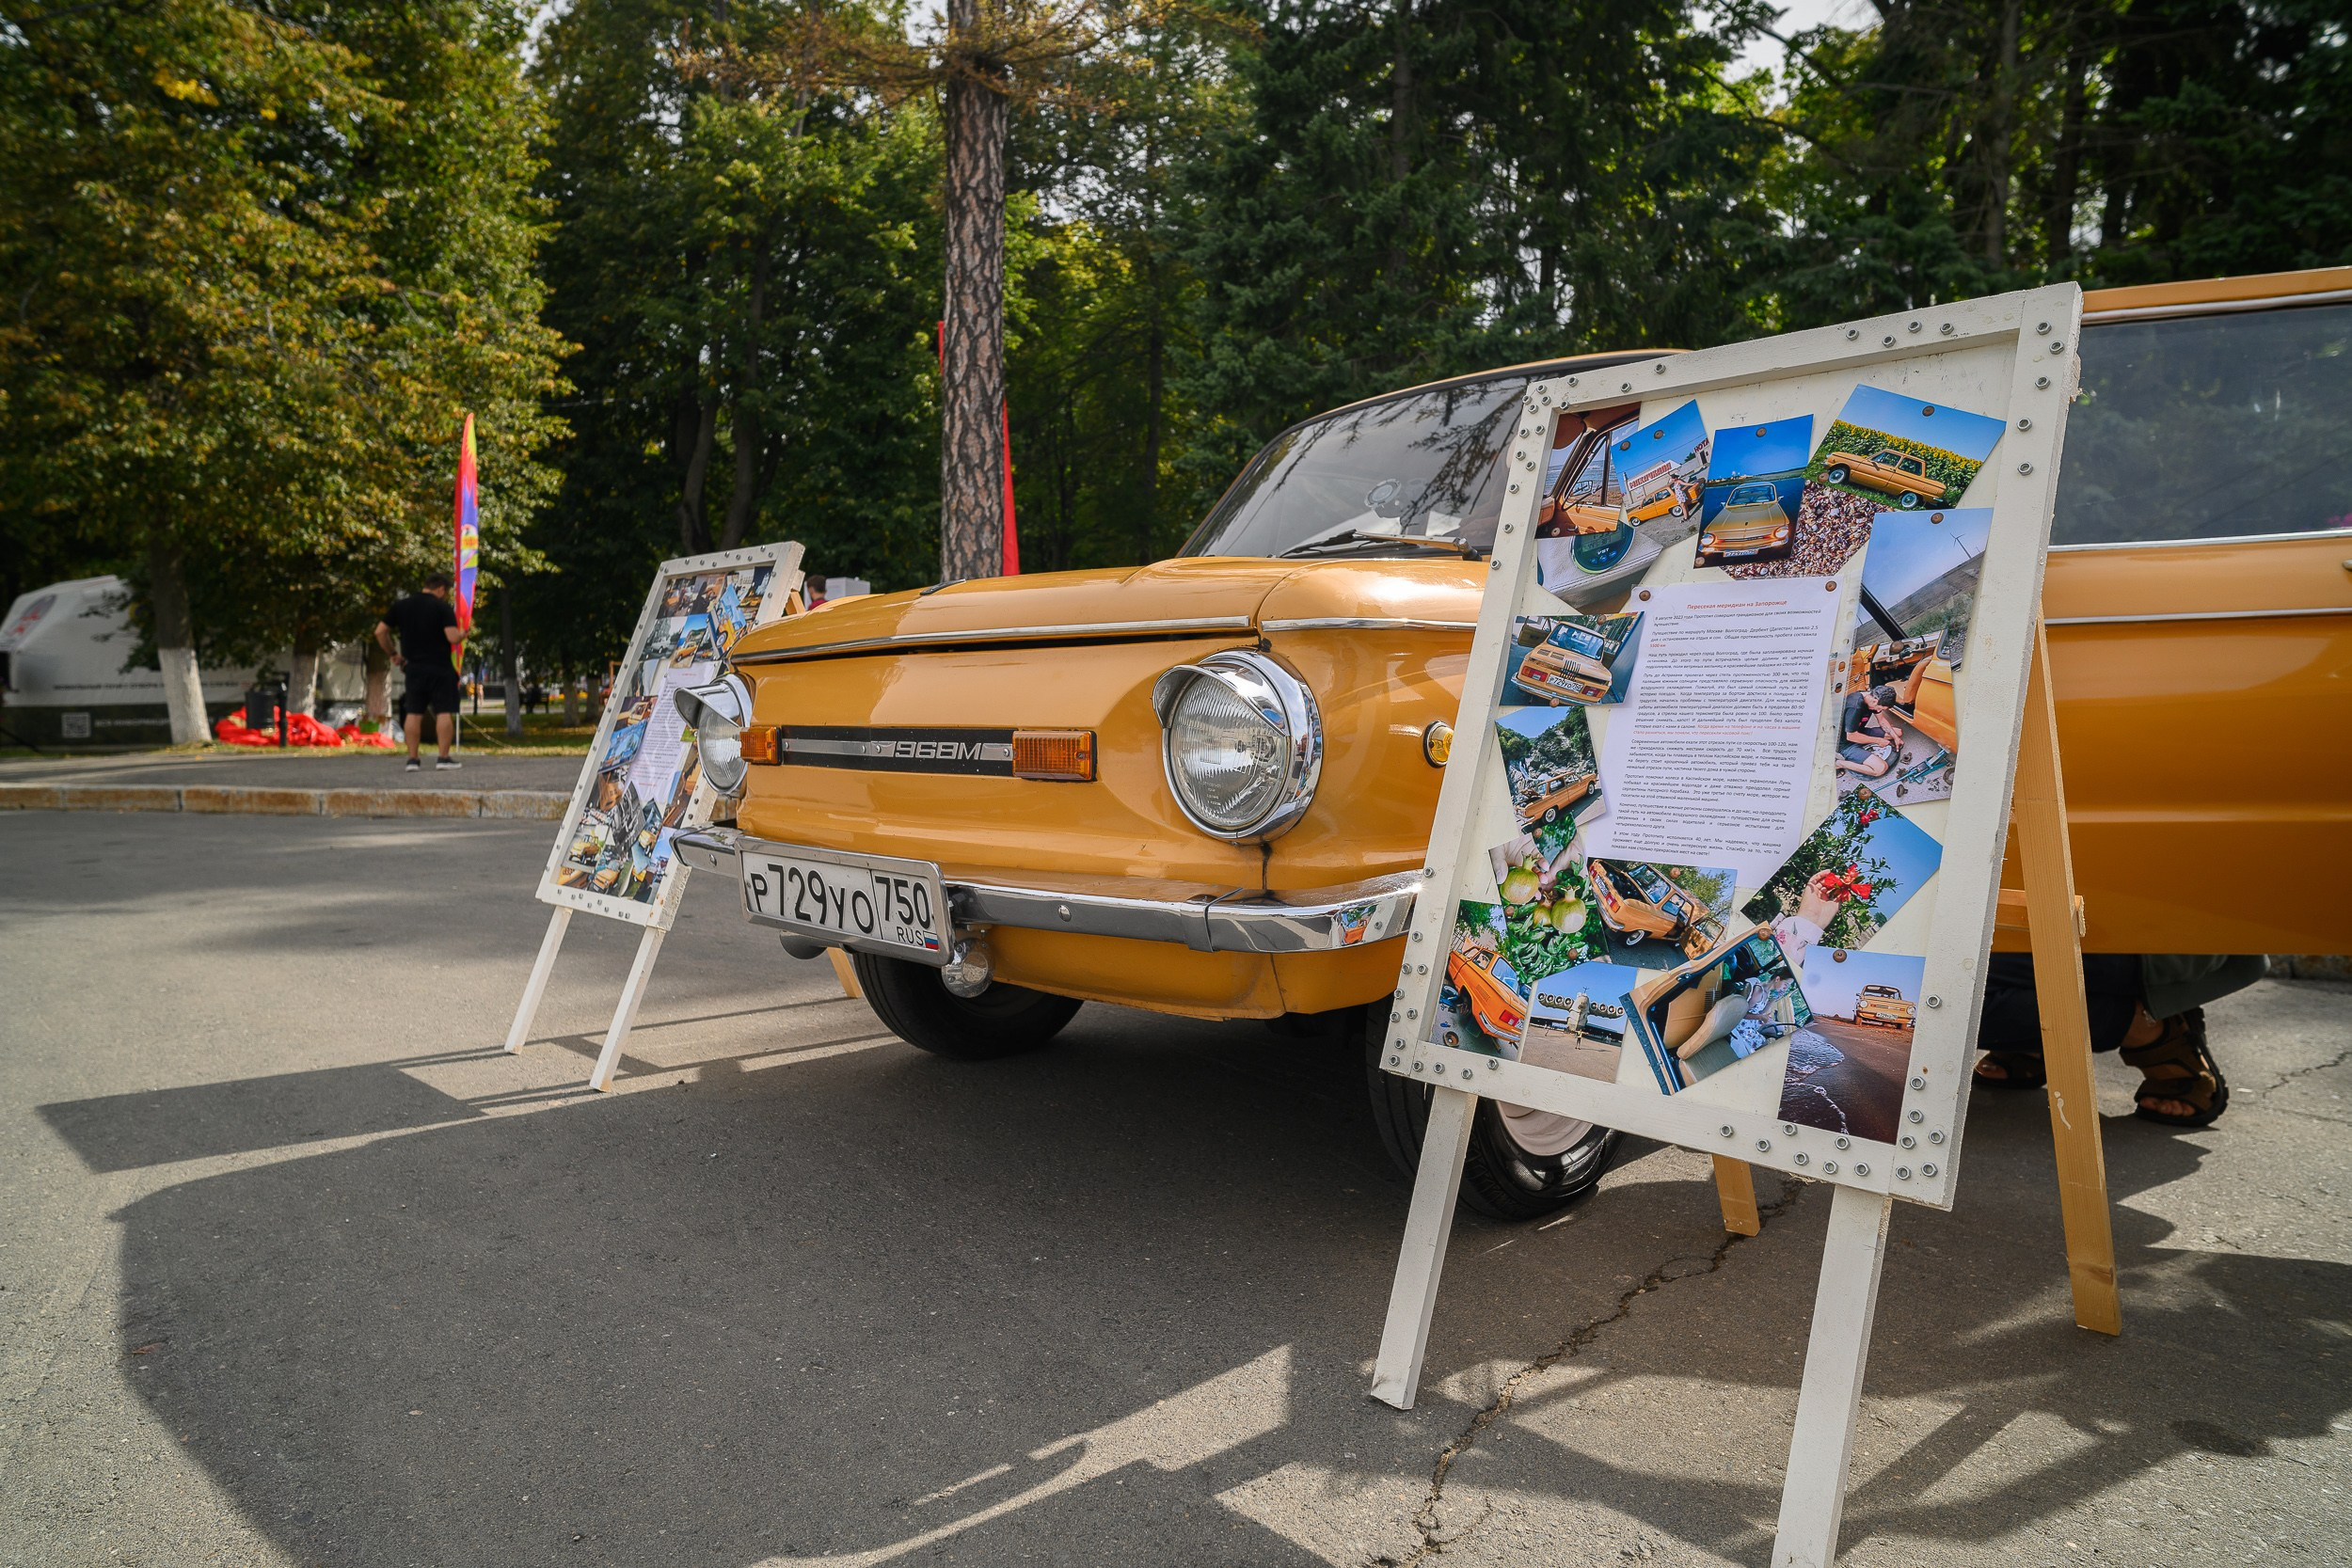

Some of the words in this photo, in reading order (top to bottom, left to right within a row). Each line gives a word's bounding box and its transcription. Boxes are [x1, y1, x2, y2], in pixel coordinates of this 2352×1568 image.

[895, 741, 982, 760] 968М
[750, 863, 874, 934] Р729УО
[875, 875, 930, 930] 750
[896, 926, 924, 946] RUS
